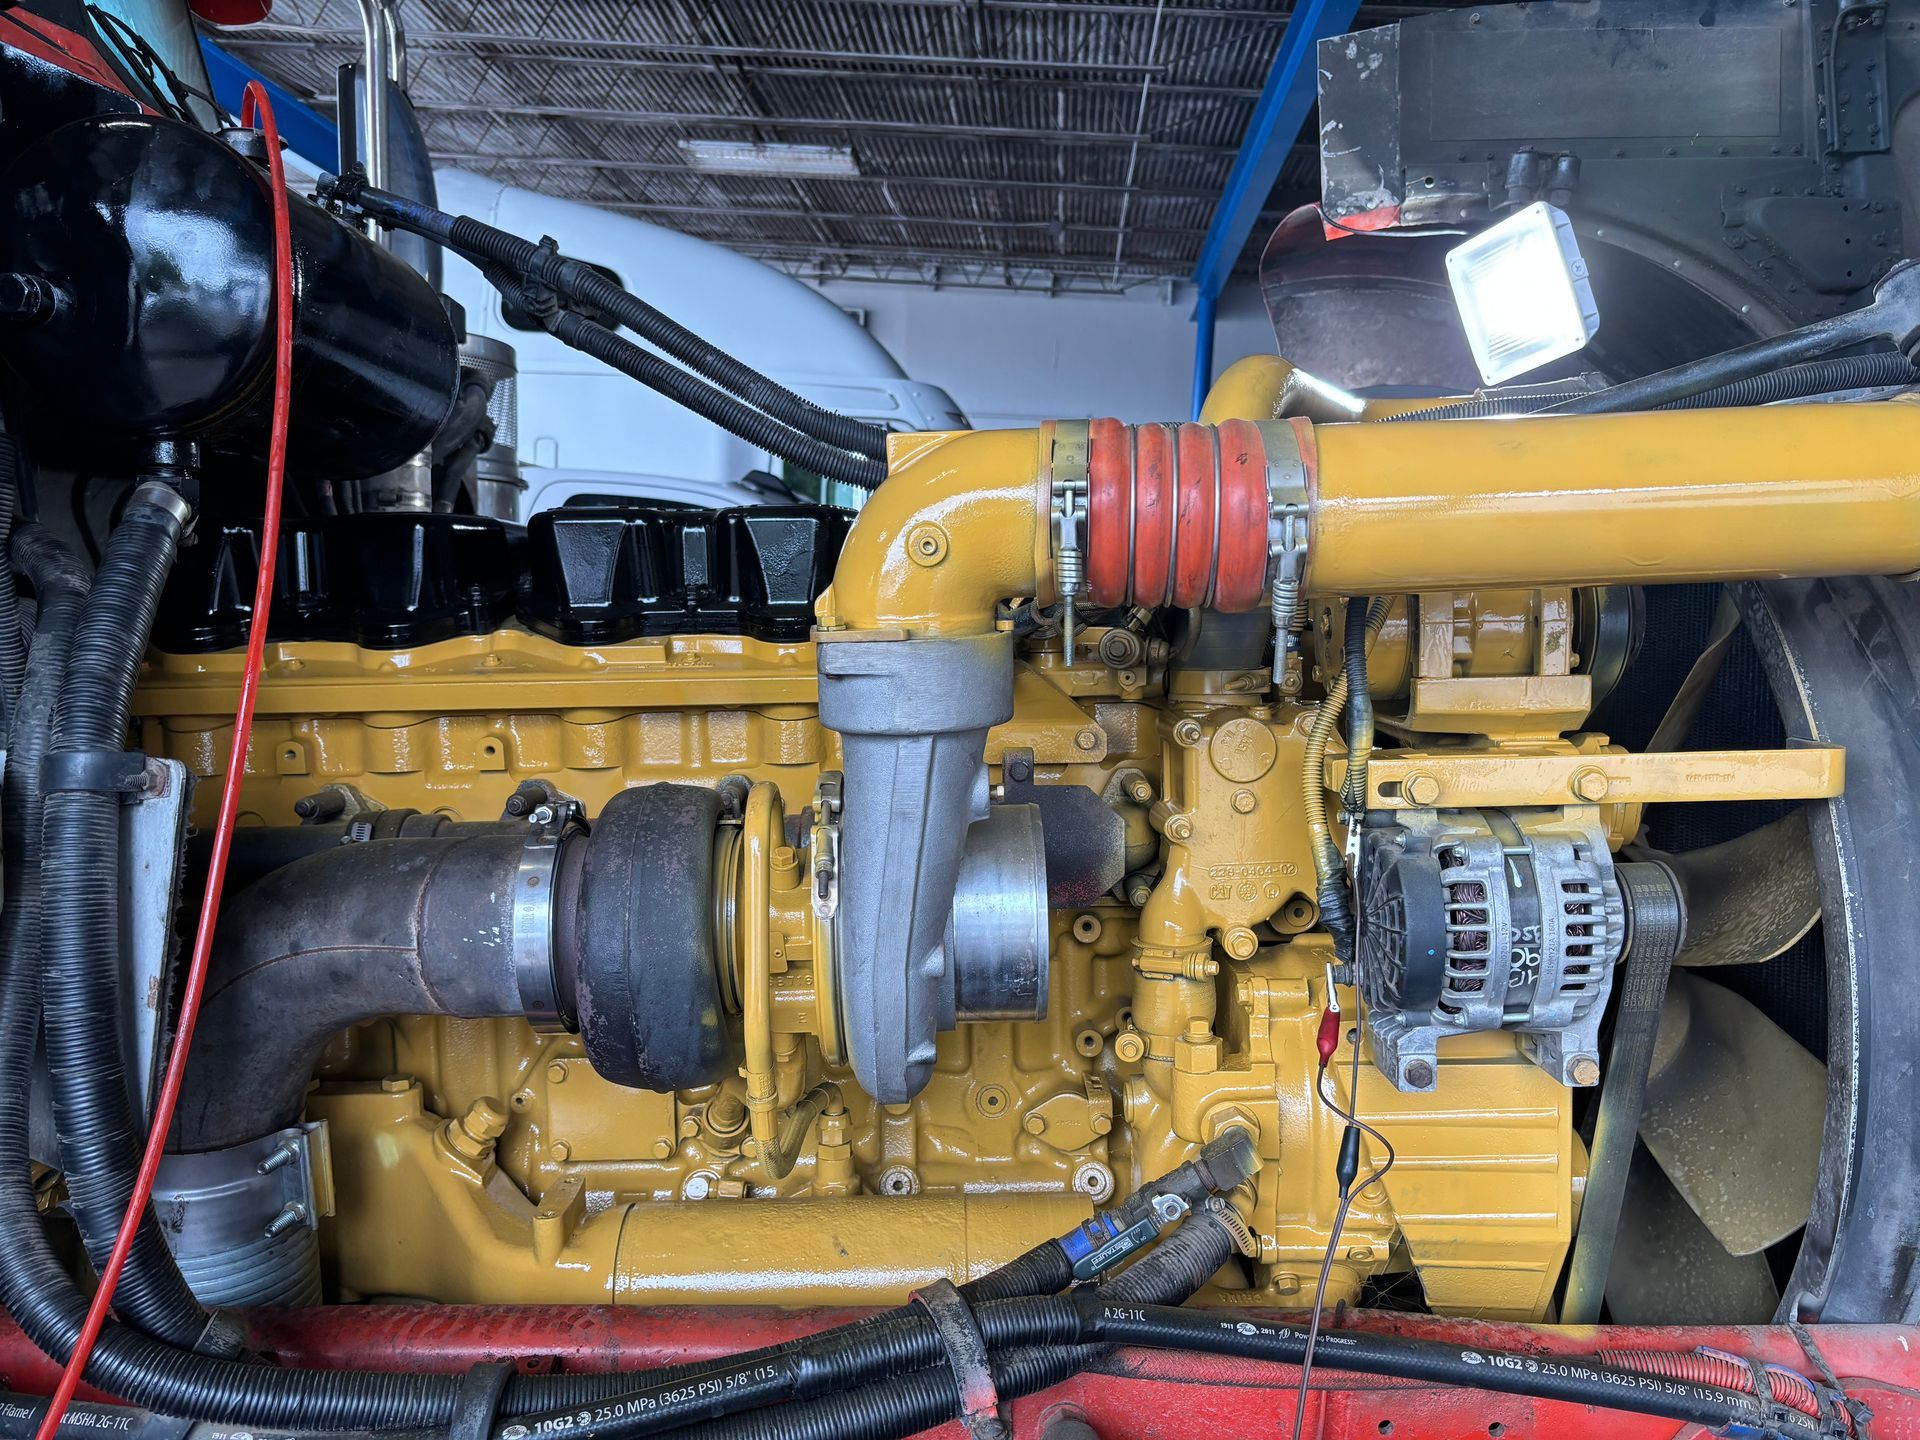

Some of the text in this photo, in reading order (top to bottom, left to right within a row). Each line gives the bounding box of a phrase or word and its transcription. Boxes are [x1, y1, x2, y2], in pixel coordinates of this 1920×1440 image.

[1112, 1308, 1146, 1322] 2G-11C
[1487, 1355, 1523, 1371] 10G2
[1542, 1362, 1569, 1378] 25.0
[1570, 1365, 1599, 1382] MPa
[1600, 1369, 1637, 1389] (3625
[1639, 1375, 1663, 1392] PSI)
[1665, 1378, 1691, 1397] 5/8"
[1693, 1384, 1724, 1404] (15.9
[2, 1404, 28, 1418] Flame
[68, 1411, 95, 1428] MSHA
[95, 1414, 134, 1431] 2G-11C
[535, 1416, 574, 1434] 10G2
[595, 1404, 625, 1422] 25.0
[627, 1398, 657, 1413] MPa
[659, 1388, 696, 1407] (3625
[698, 1381, 723, 1398] PSI)
[725, 1370, 752, 1390] 5/8"
